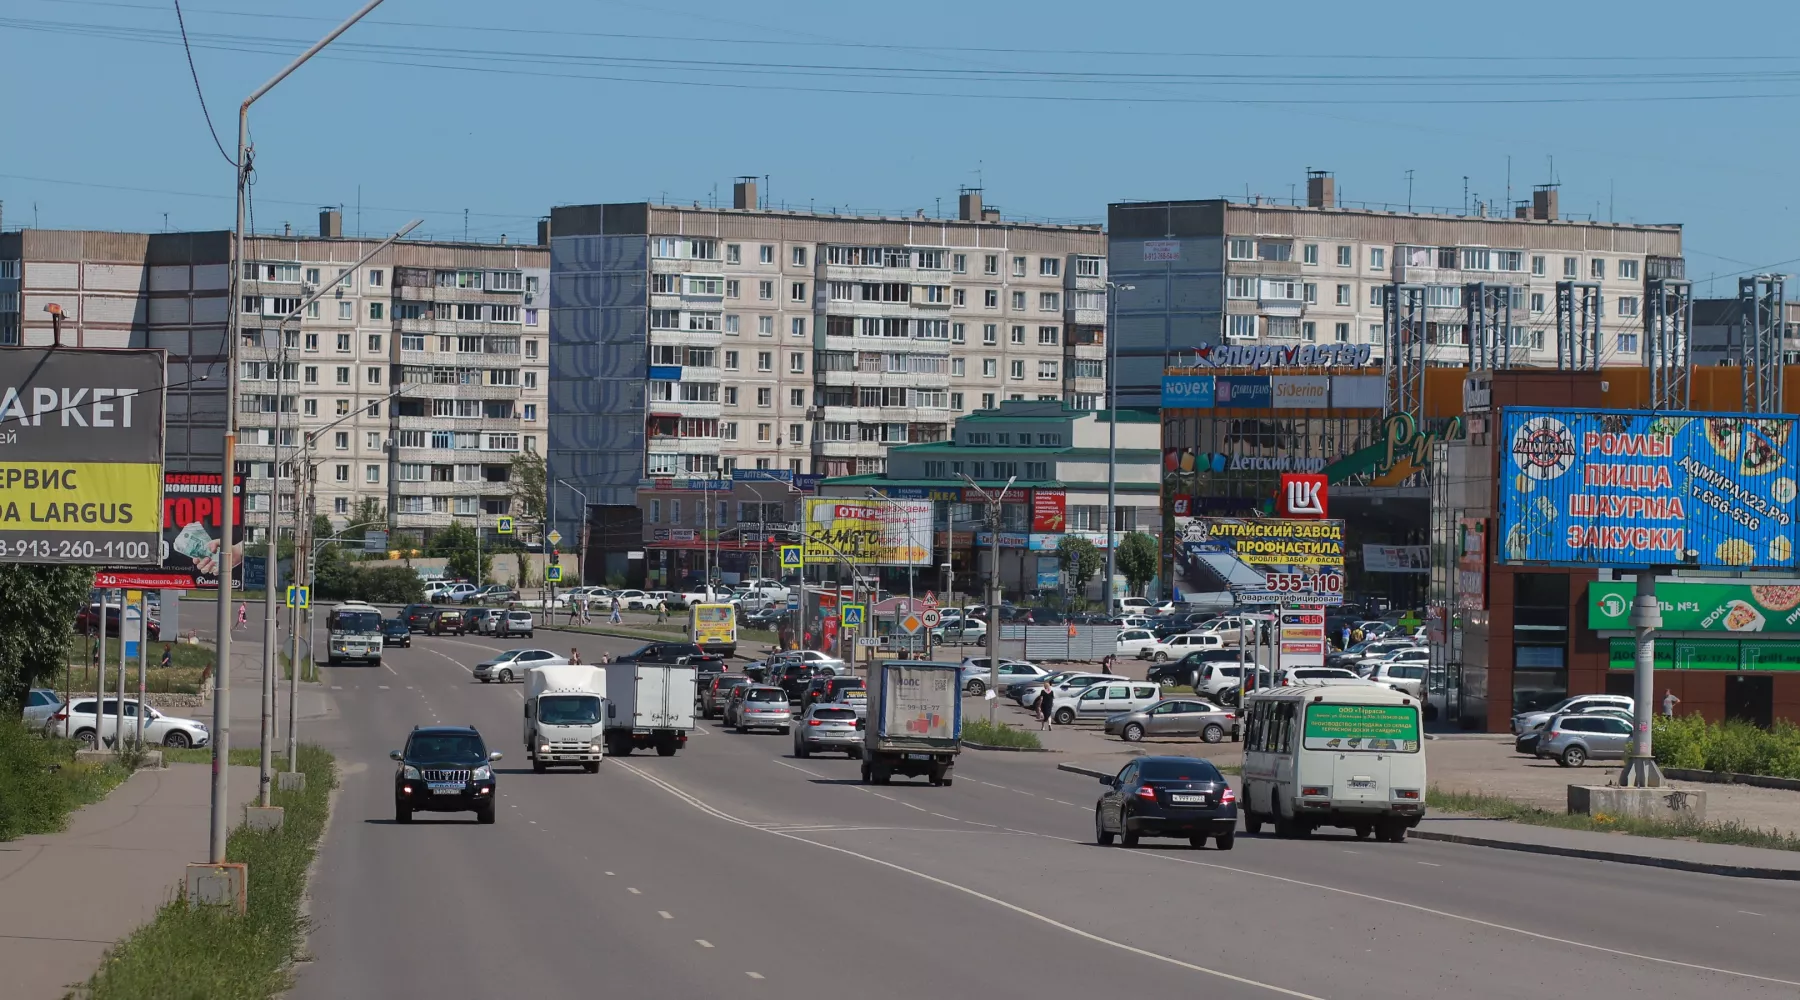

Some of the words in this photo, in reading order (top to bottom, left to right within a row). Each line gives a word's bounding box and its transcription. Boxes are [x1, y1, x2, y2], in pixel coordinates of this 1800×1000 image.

[1230, 453, 1292, 471] Детский
[1294, 456, 1325, 473] мир
[1584, 462, 1673, 492] ПИЦЦА
[30, 502, 133, 523] LARGUS
[1569, 493, 1685, 520] ШАУРМА
[1209, 521, 1292, 538] АЛТАЙСКИЙ
[1294, 524, 1341, 540] ЗАВОД
[1567, 525, 1685, 551] ЗАКУСКИ
[1236, 540, 1341, 554] ПРОФНАСТИЛА
[1315, 556, 1341, 564] ФАСАД
[1265, 573, 1341, 592] 555-110
[925, 613, 936, 622] 40
